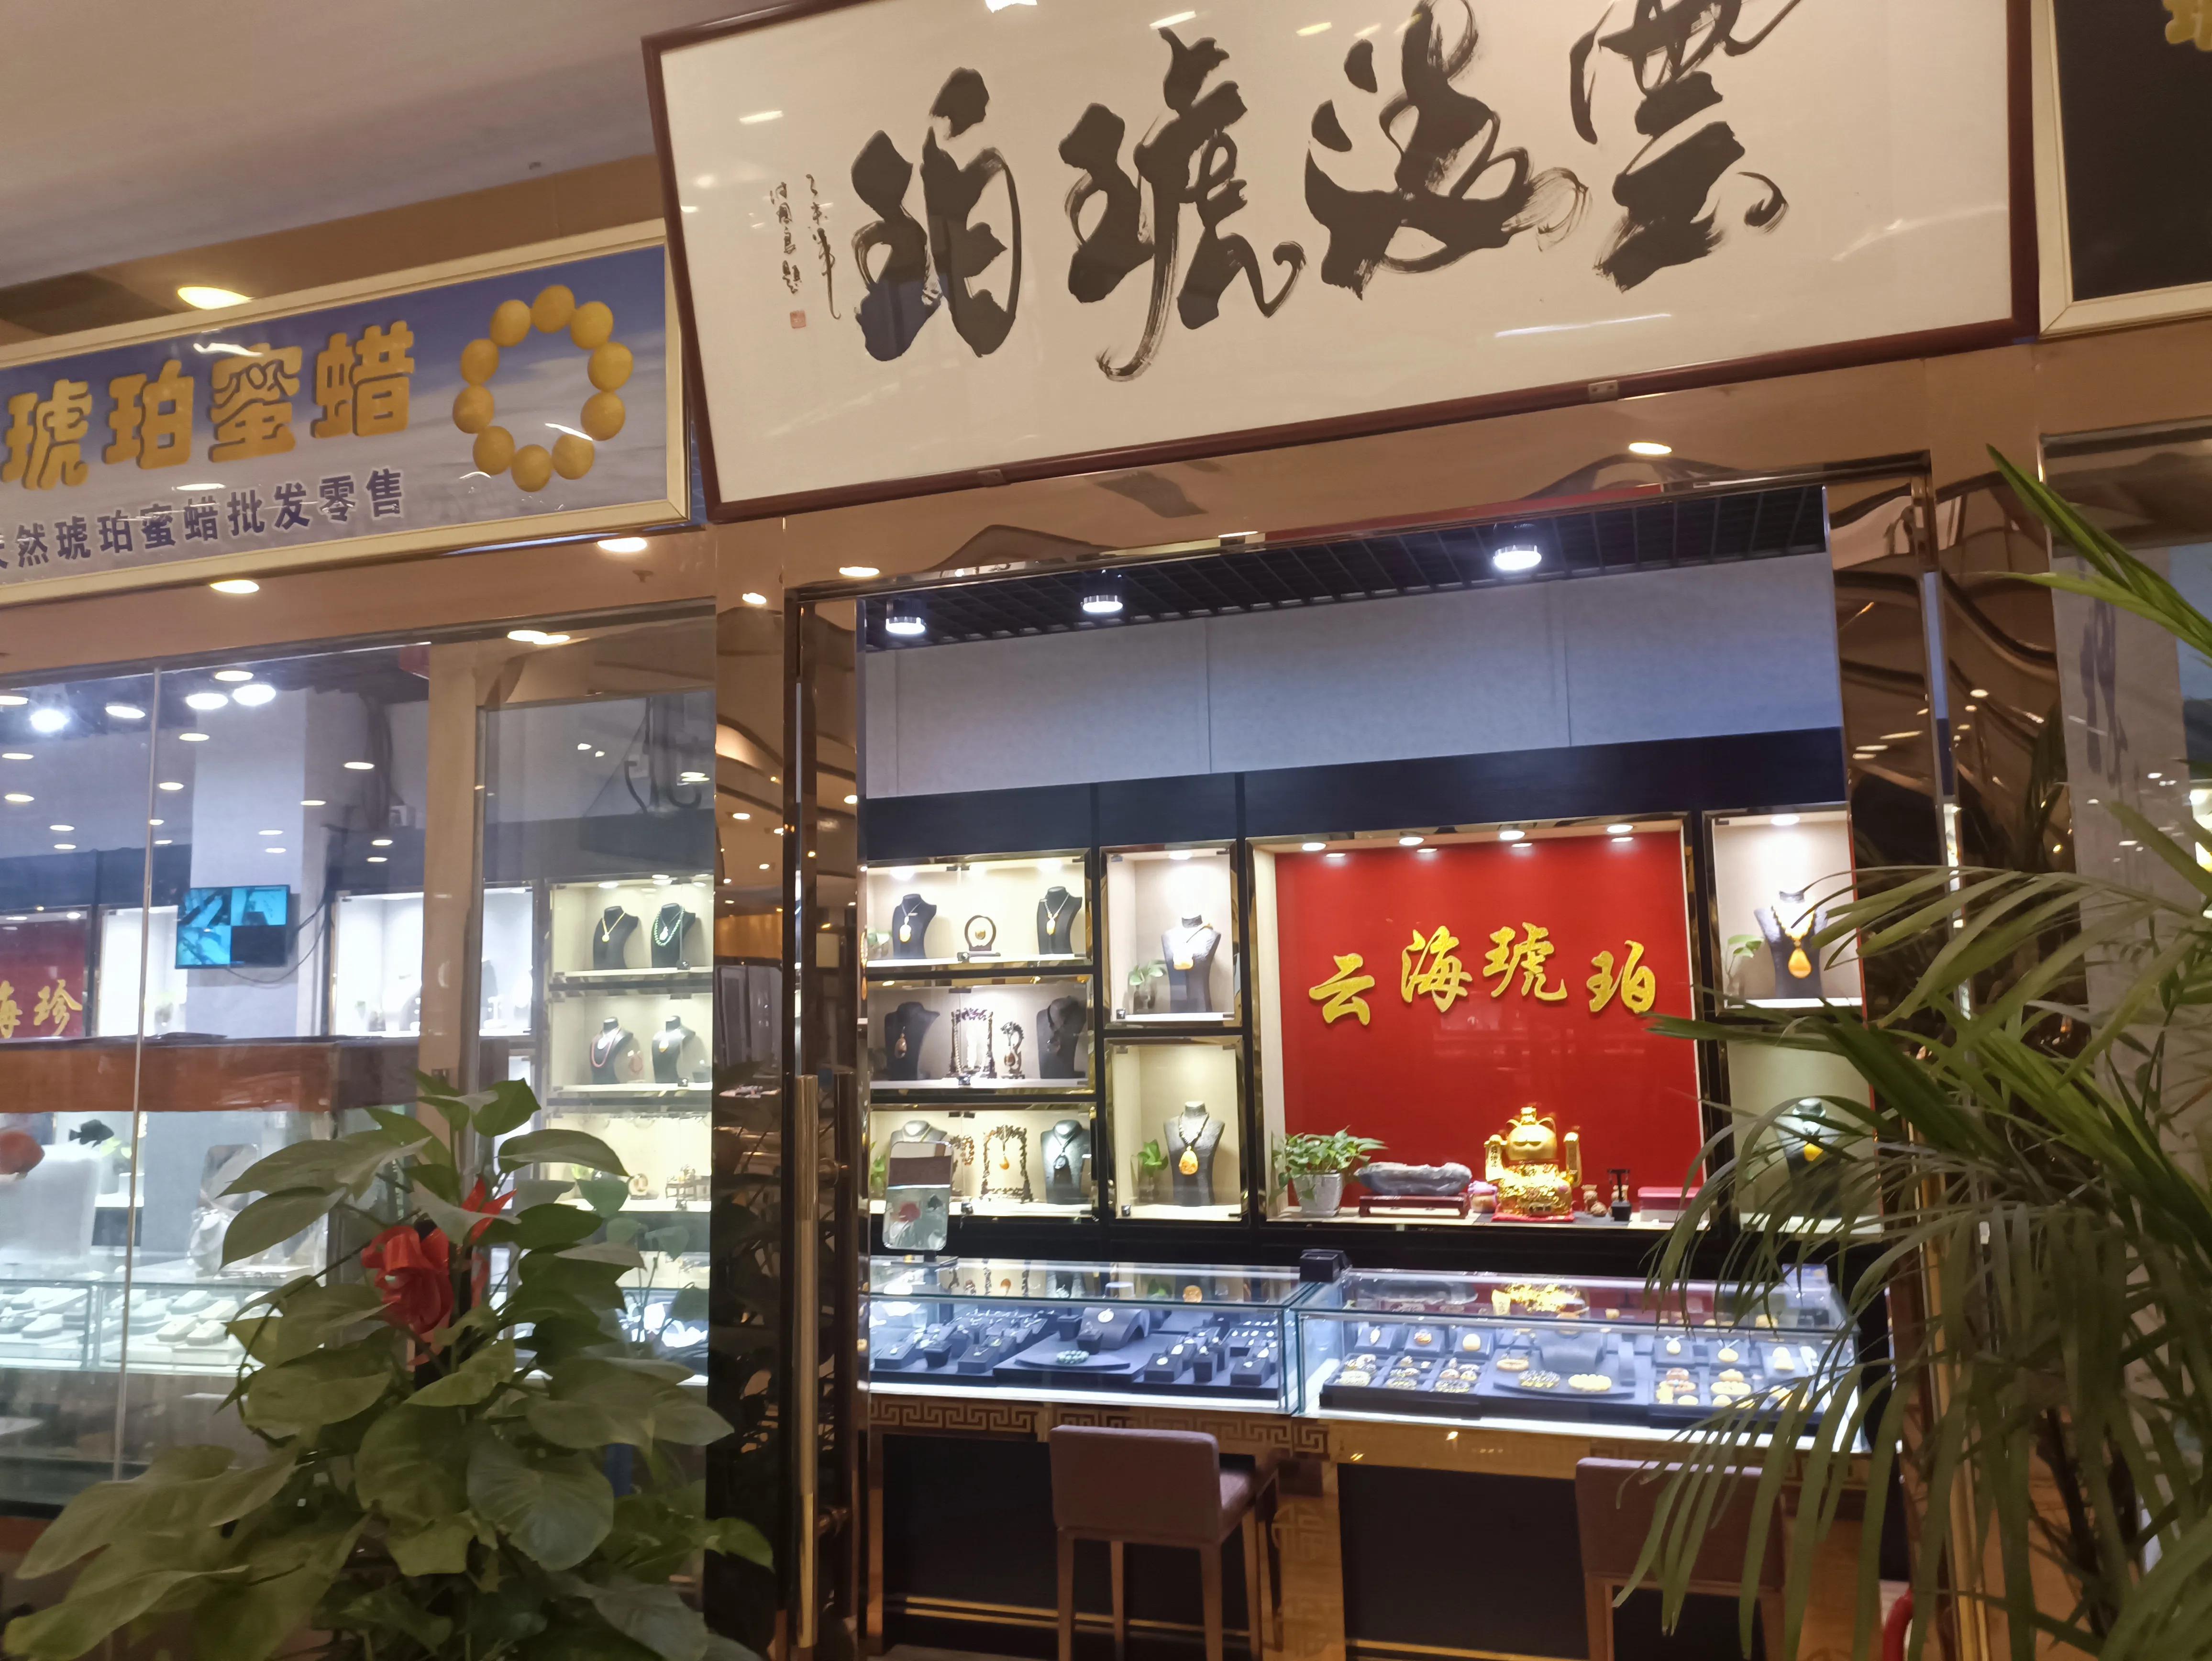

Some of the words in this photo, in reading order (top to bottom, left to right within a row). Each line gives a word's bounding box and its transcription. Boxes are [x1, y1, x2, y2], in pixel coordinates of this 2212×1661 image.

[1, 321, 414, 490] 琥珀蜜蜡
[0, 469, 403, 569] 然琥珀蜜蜡批发零售
[1309, 921, 1656, 1026] 云海琥珀
